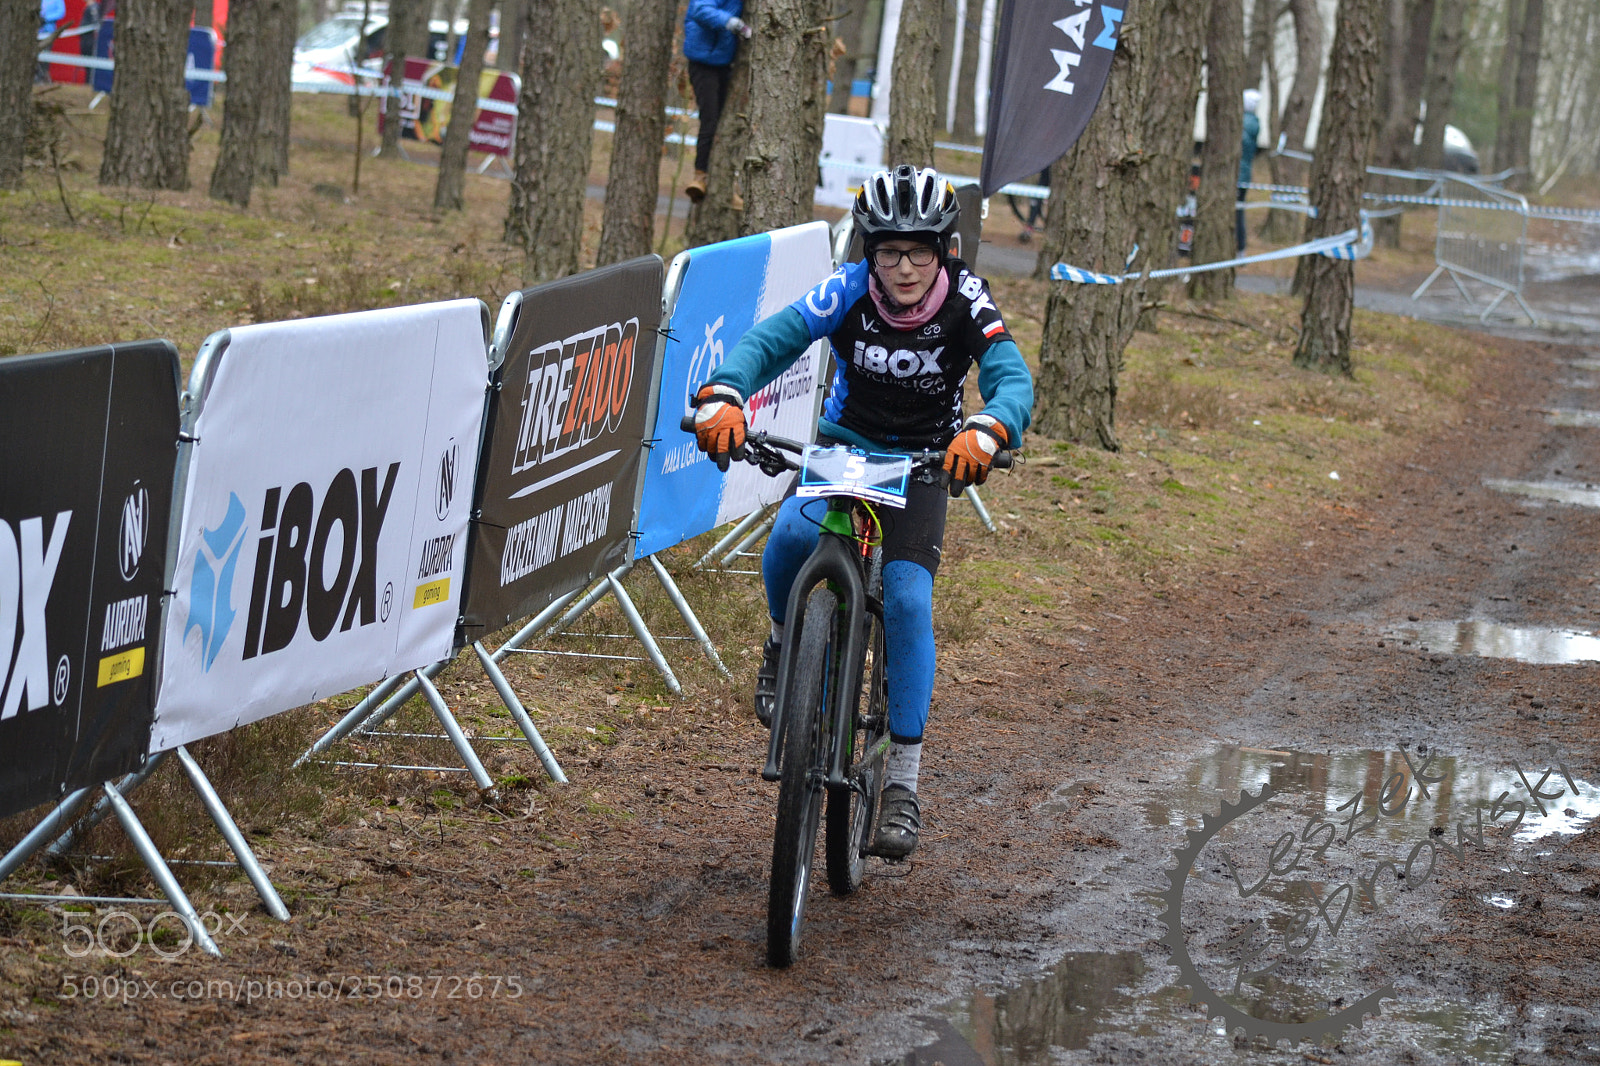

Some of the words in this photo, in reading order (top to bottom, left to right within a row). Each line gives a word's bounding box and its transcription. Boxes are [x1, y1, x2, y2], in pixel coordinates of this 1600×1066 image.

[1043, 0, 1094, 95] MA
[957, 269, 997, 320] iBX
[853, 340, 946, 379] iBOX
[511, 316, 640, 476] TREZADO
[842, 455, 867, 480] 5
[242, 461, 402, 661] iBOX
[418, 532, 456, 580] AURORA
[422, 584, 441, 604] gaming
[101, 593, 149, 652] AURORA
[108, 656, 131, 681] gaming
